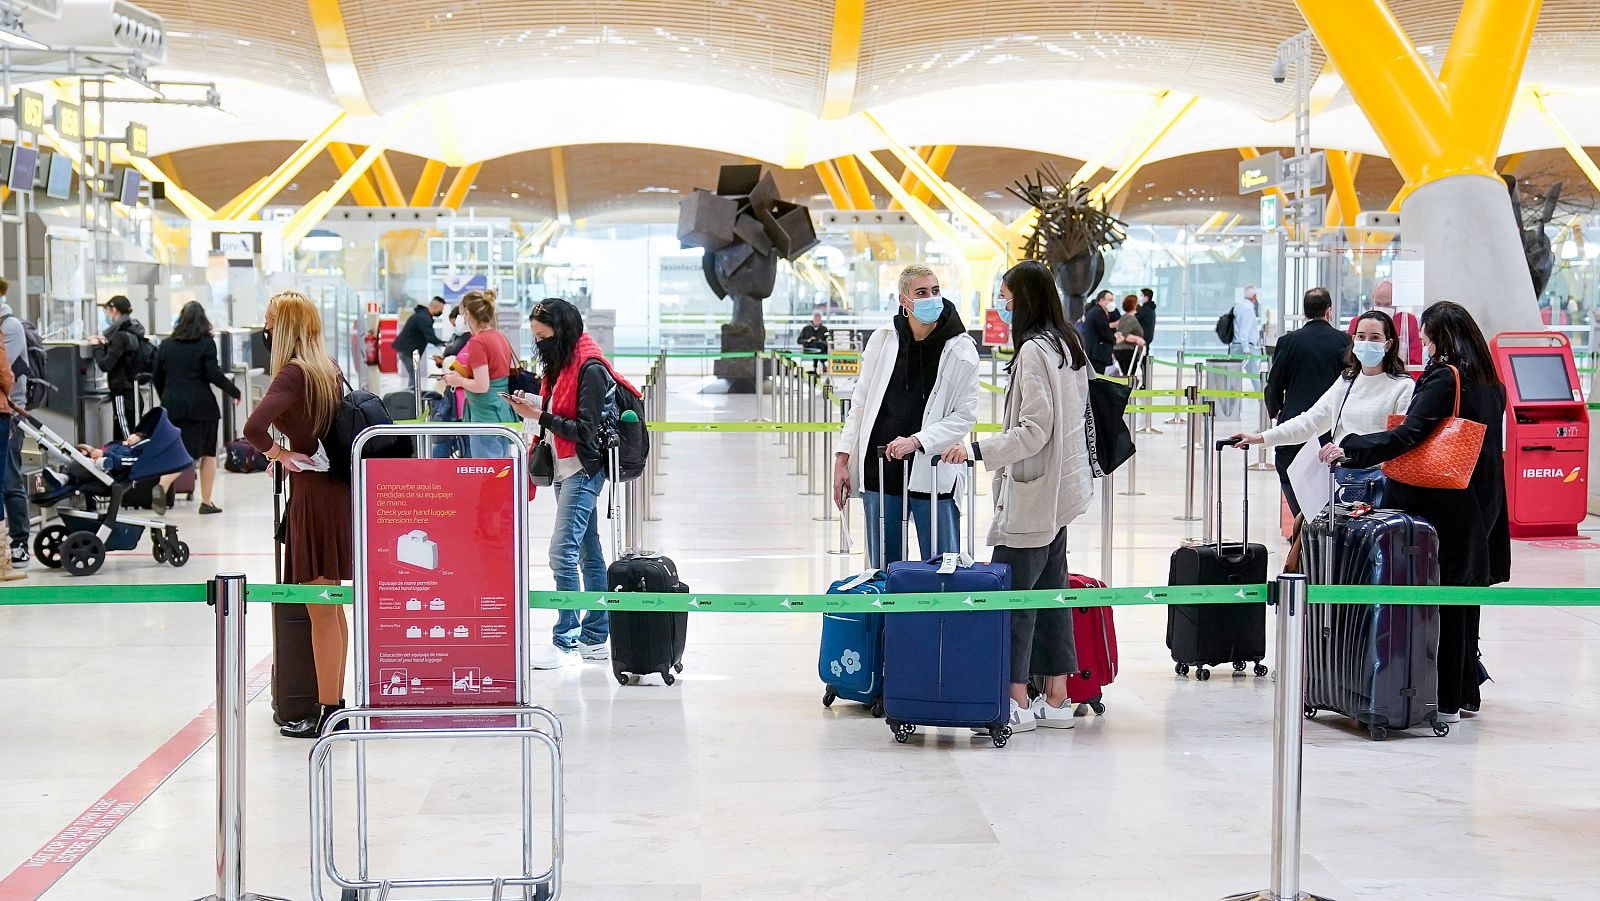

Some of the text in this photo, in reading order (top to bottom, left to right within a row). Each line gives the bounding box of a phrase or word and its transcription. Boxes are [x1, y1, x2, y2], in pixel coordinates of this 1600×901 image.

[456, 466, 496, 474] IBERIA
[1523, 468, 1564, 478] IBERIA
[430, 509, 456, 517] luggage
[55, 827, 88, 839] YOUR
